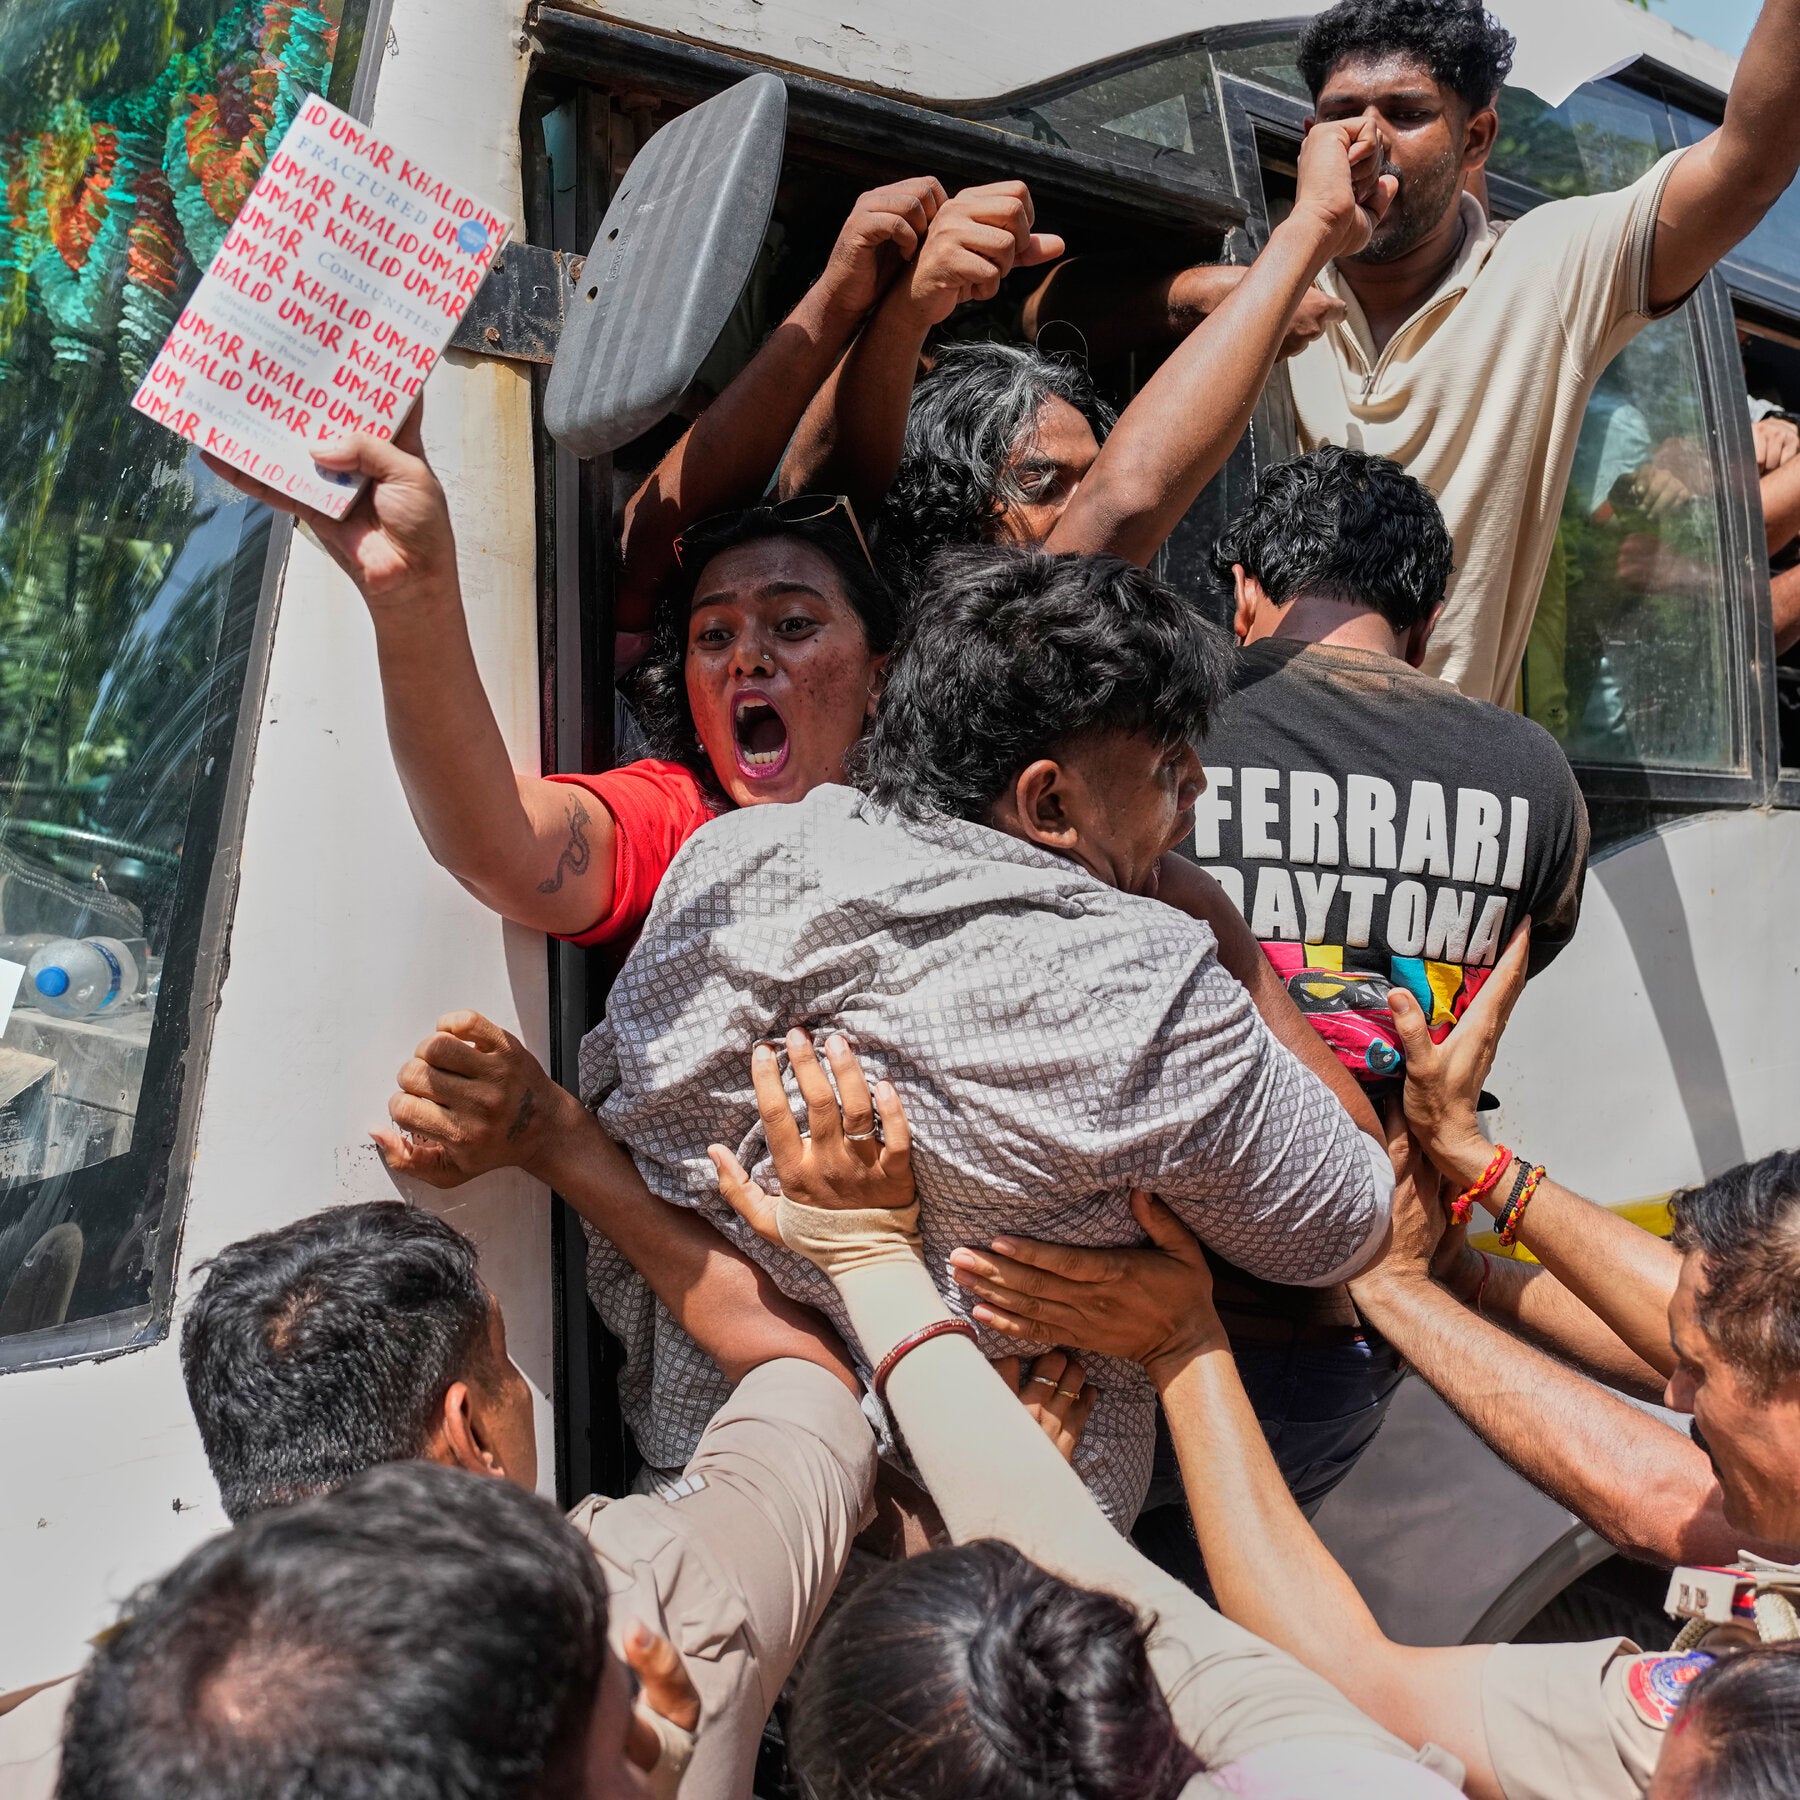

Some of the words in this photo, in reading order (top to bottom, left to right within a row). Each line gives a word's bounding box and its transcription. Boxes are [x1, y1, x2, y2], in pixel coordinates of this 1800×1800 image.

[296, 136, 428, 225] FRACTURED
[300, 105, 327, 126] ID
[329, 117, 394, 174] UMAR
[399, 160, 474, 219] KHALID
[235, 197, 303, 258] UMAR
[250, 176, 319, 231] UMAR
[323, 217, 402, 277] KHALID
[403, 269, 467, 321] UMAR
[271, 152, 336, 207] UMAR
[340, 193, 419, 254] KHALID
[418, 244, 480, 296] UMAR
[224, 230, 288, 284] UMAR
[292, 270, 372, 330] KHALID
[372, 321, 436, 373] UMAR
[224, 312, 267, 344] Politics
[263, 336, 278, 351] of
[275, 343, 310, 370] Power
[251, 312, 300, 346] Histories
[297, 339, 321, 359] and
[278, 298, 343, 353] UMAR
[151, 362, 186, 397] UM
[163, 333, 243, 391] KHALID
[246, 384, 311, 438] UMAR
[178, 310, 244, 363] UMAR
[248, 349, 328, 409] KHALID
[332, 365, 398, 420] UMAR
[136, 387, 201, 442] UMAR
[204, 427, 285, 482] KHALID
[1194, 766, 1530, 891] FERRARI
